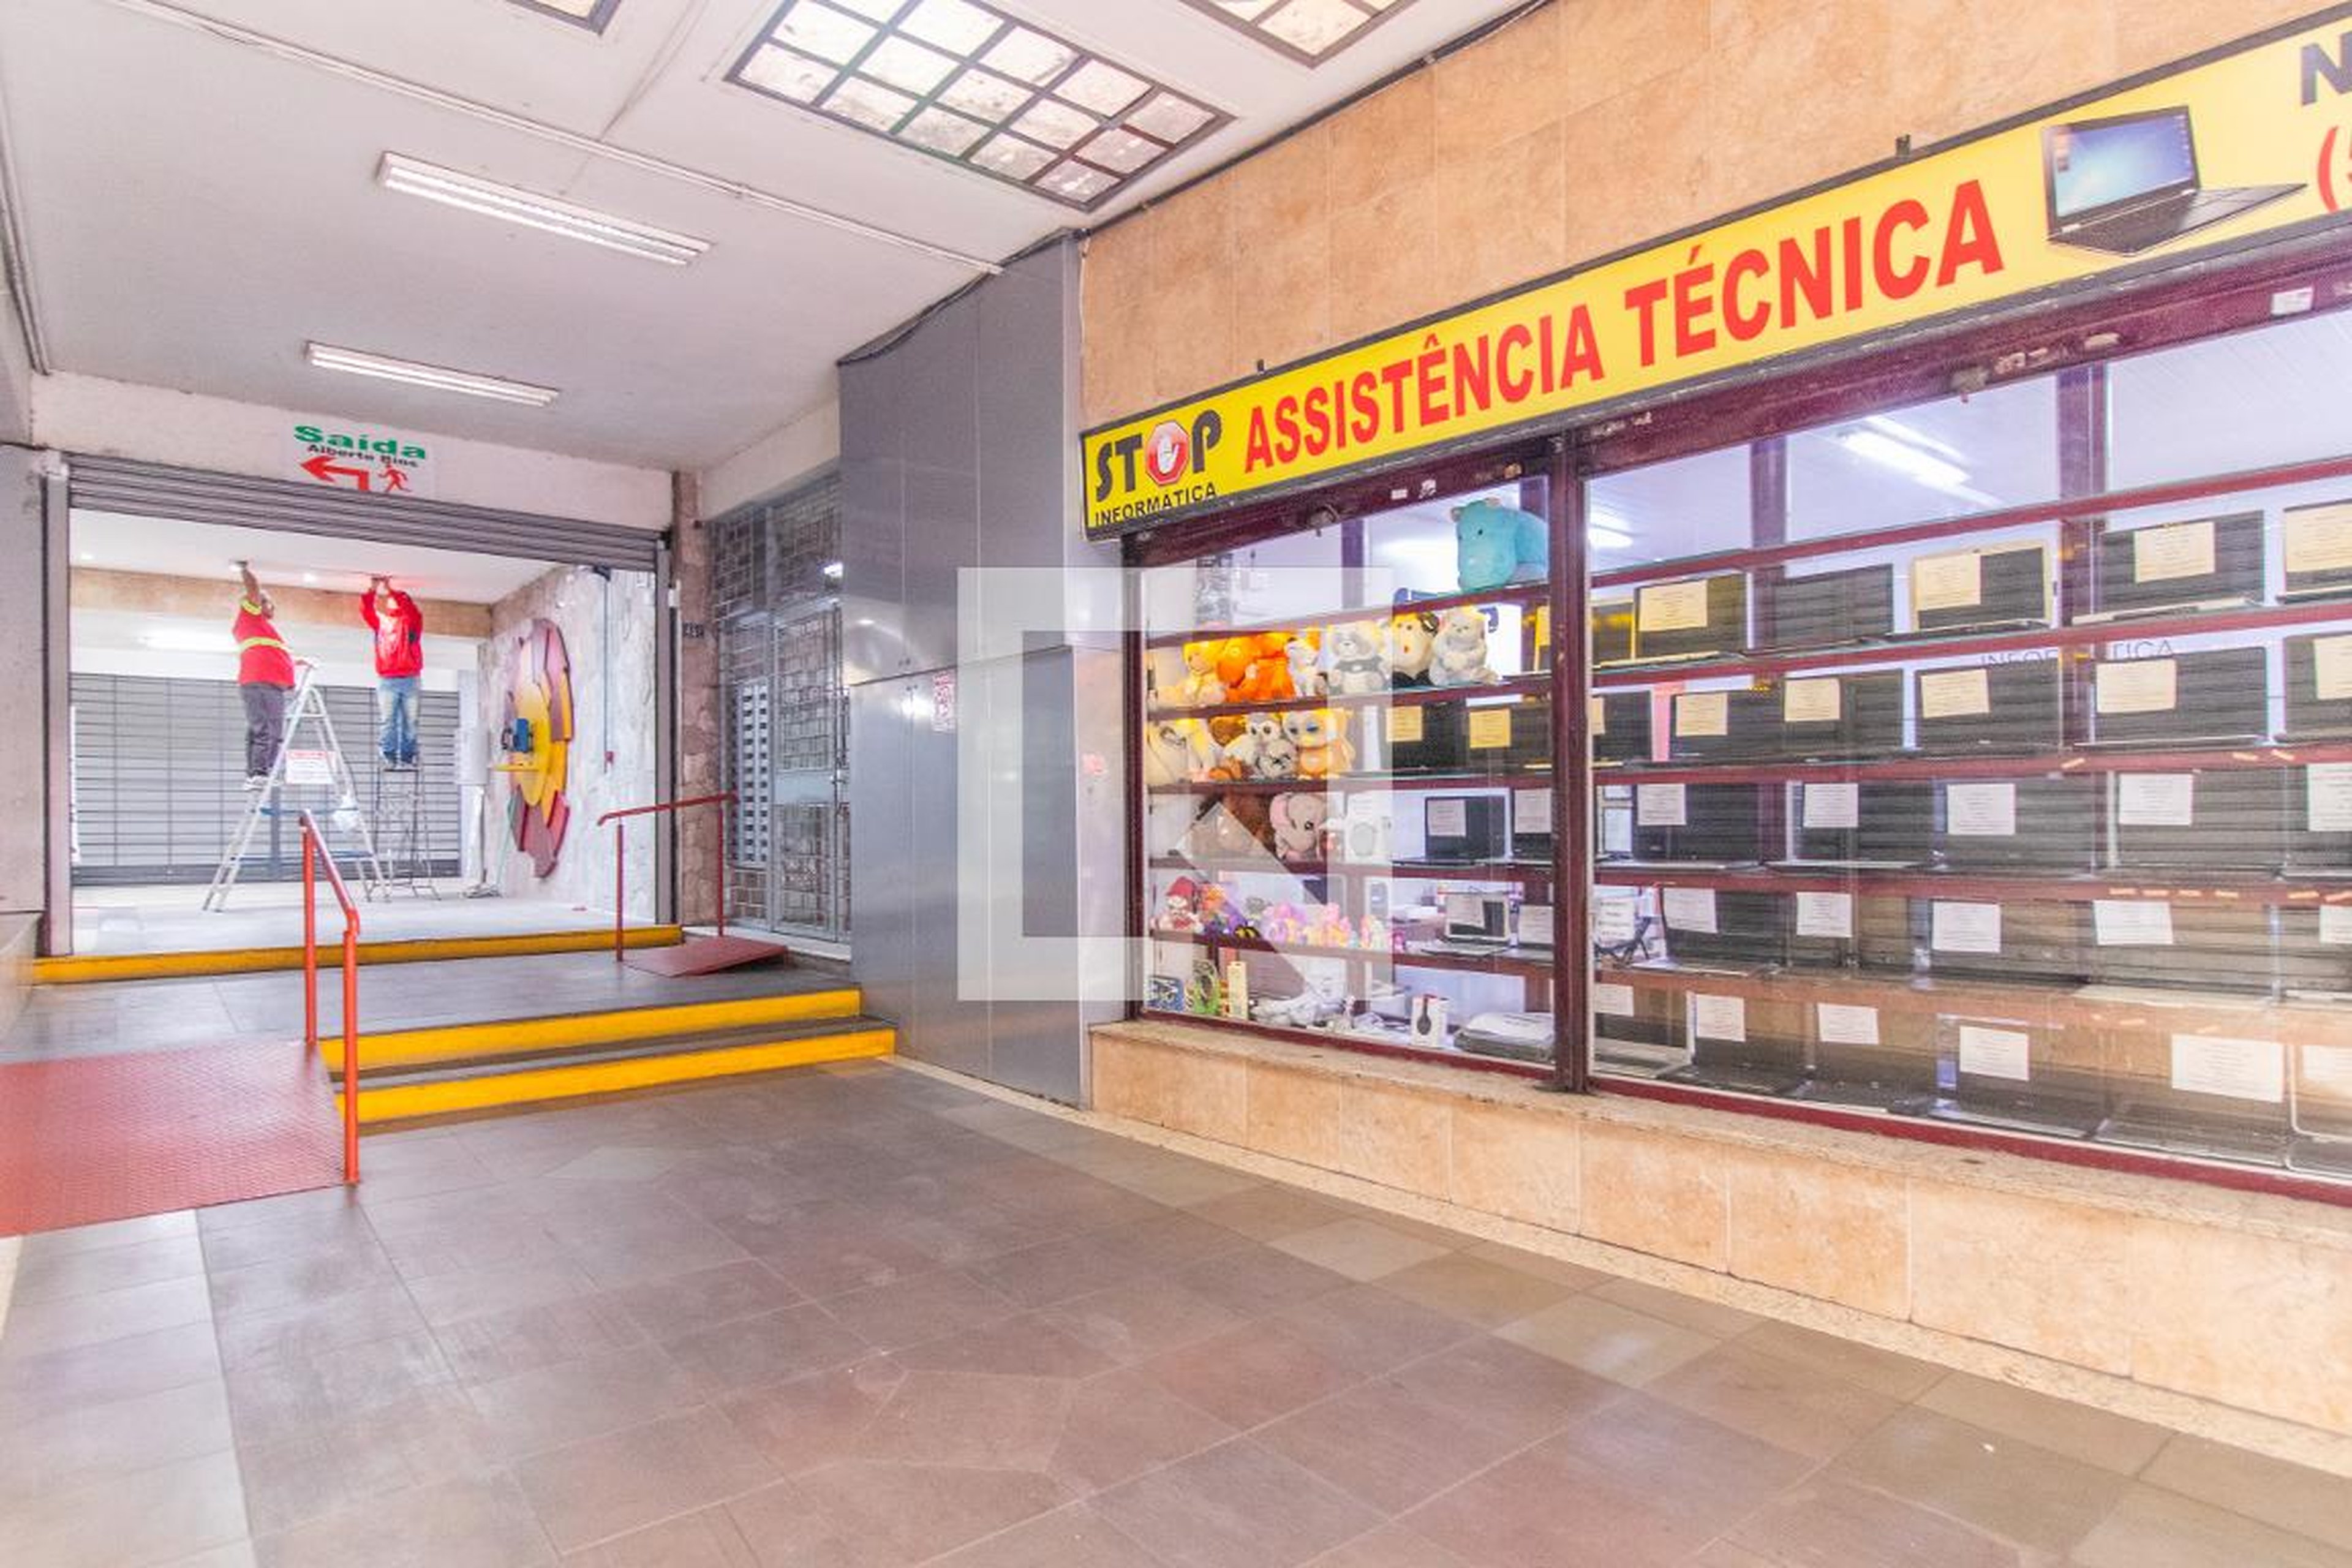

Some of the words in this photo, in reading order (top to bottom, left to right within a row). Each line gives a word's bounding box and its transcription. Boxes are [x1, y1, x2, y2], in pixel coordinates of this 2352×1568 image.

[1244, 303, 1605, 473] ASSISTÊNCIA
[1624, 178, 2005, 368] TÉCNICA
[307, 443, 375, 461] Alberto
[1096, 409, 1223, 503] STOP
